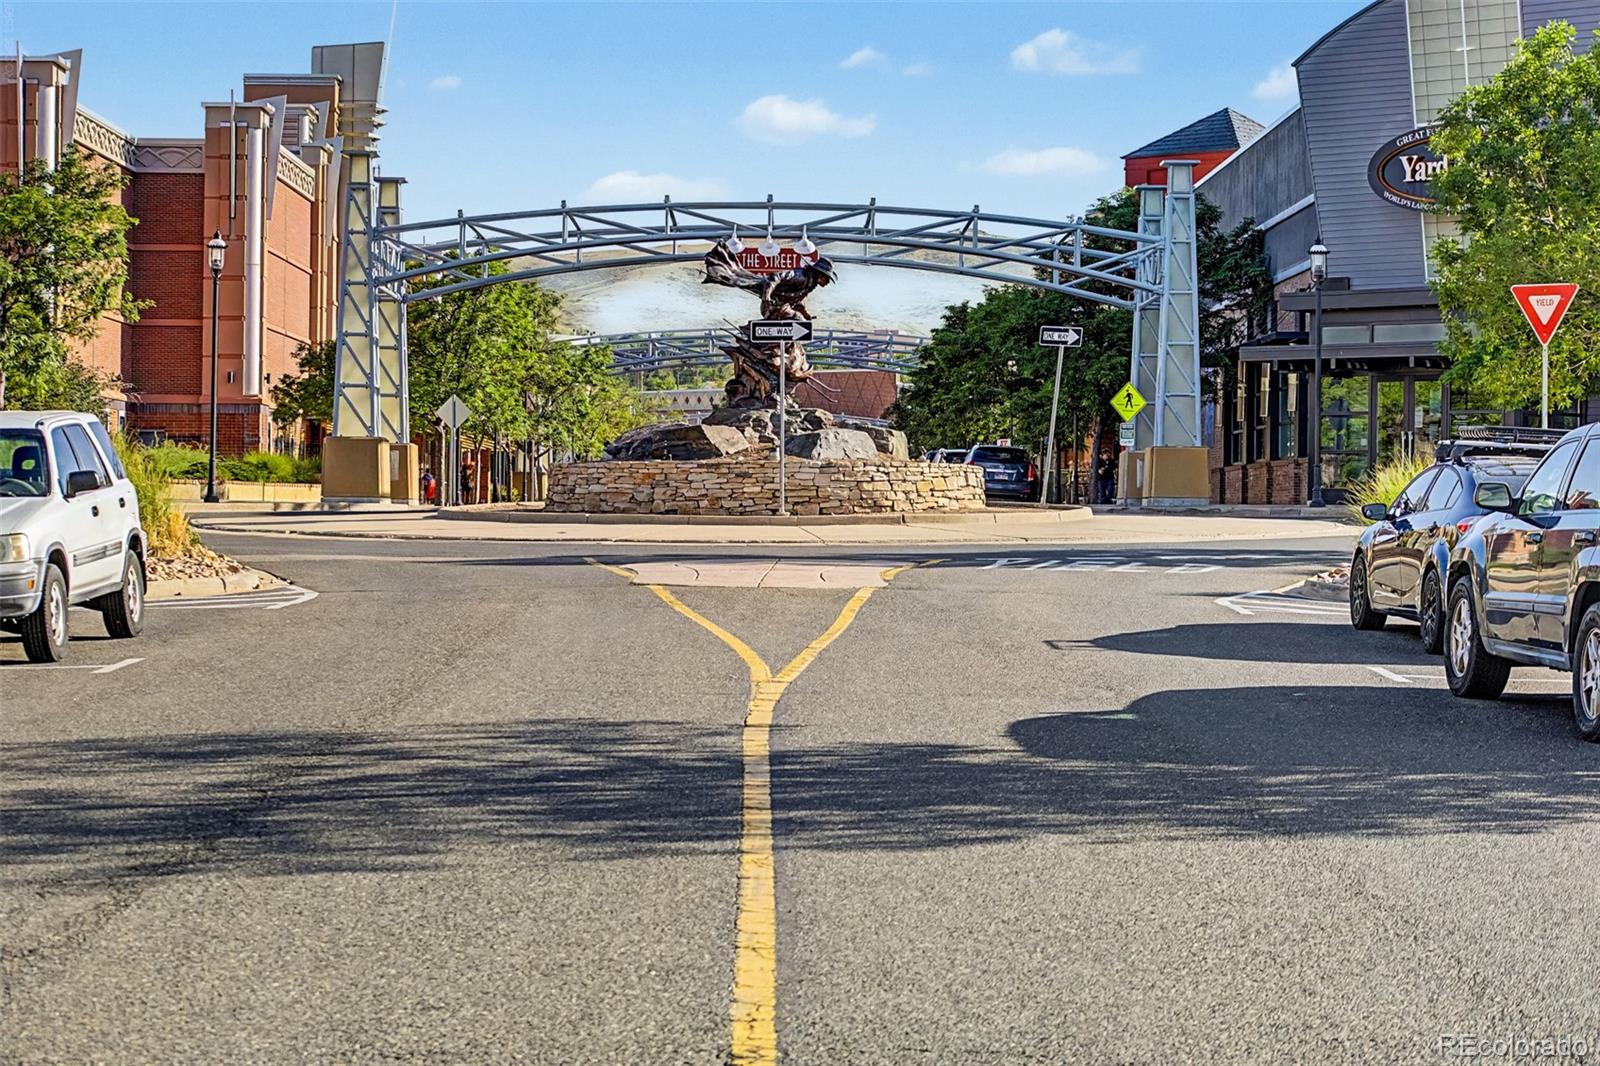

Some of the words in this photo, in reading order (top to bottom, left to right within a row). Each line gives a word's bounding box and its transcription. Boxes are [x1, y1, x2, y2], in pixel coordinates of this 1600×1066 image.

[1396, 130, 1424, 147] GREAT
[1399, 154, 1449, 182] Yard
[742, 253, 760, 268] THE
[764, 253, 798, 269] STREET
[1535, 298, 1555, 307] YIELD
[756, 327, 773, 336] ONE
[776, 327, 794, 336] WAY
[1043, 331, 1055, 340] ONE
